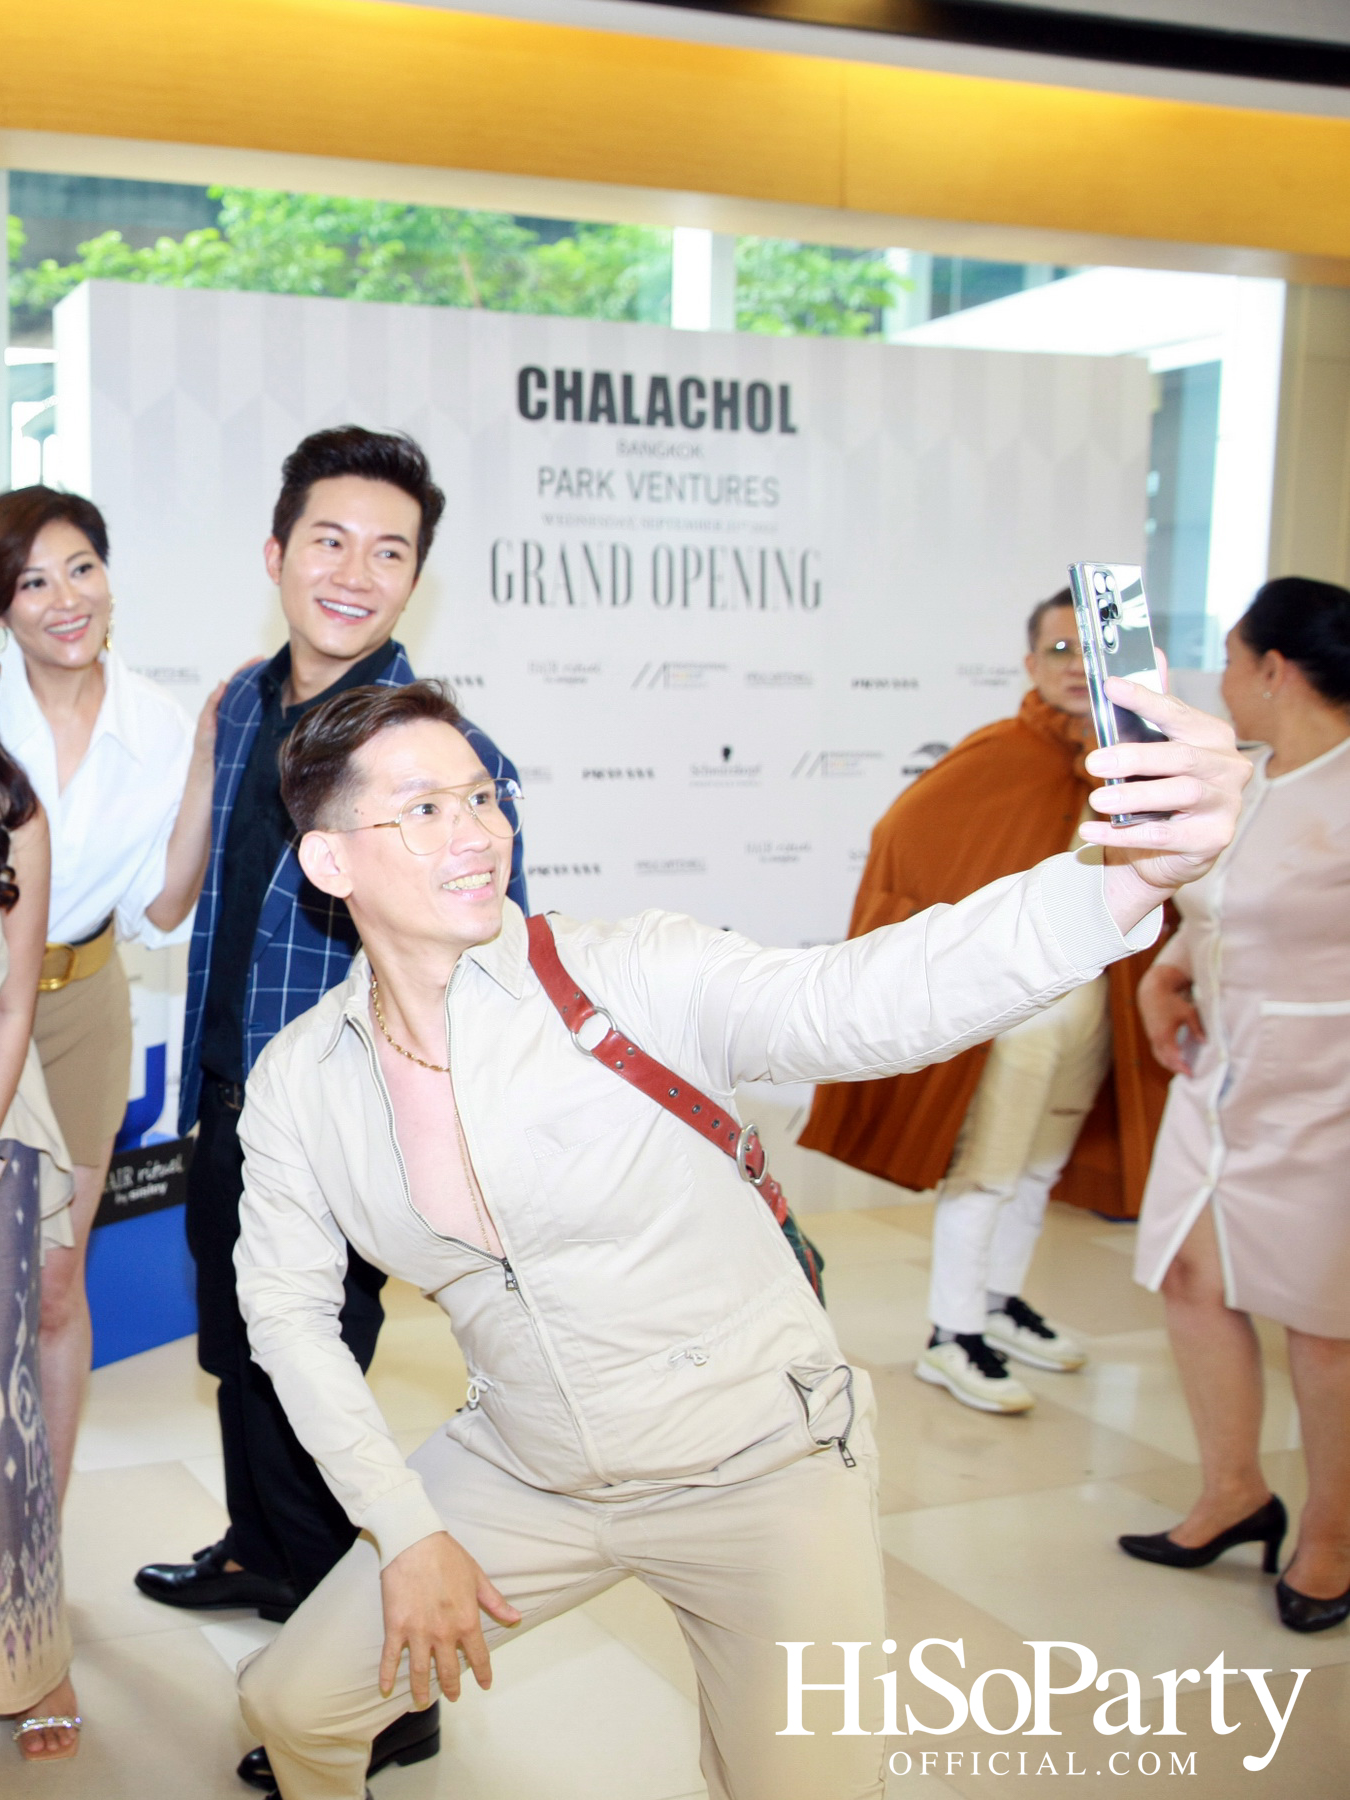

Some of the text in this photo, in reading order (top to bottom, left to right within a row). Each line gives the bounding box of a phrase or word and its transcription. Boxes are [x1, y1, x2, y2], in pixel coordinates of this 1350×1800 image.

[516, 365, 798, 435] CHALACHOL
[537, 466, 780, 508] PARK VENTURES
[490, 536, 823, 612] GRAND OPENING
